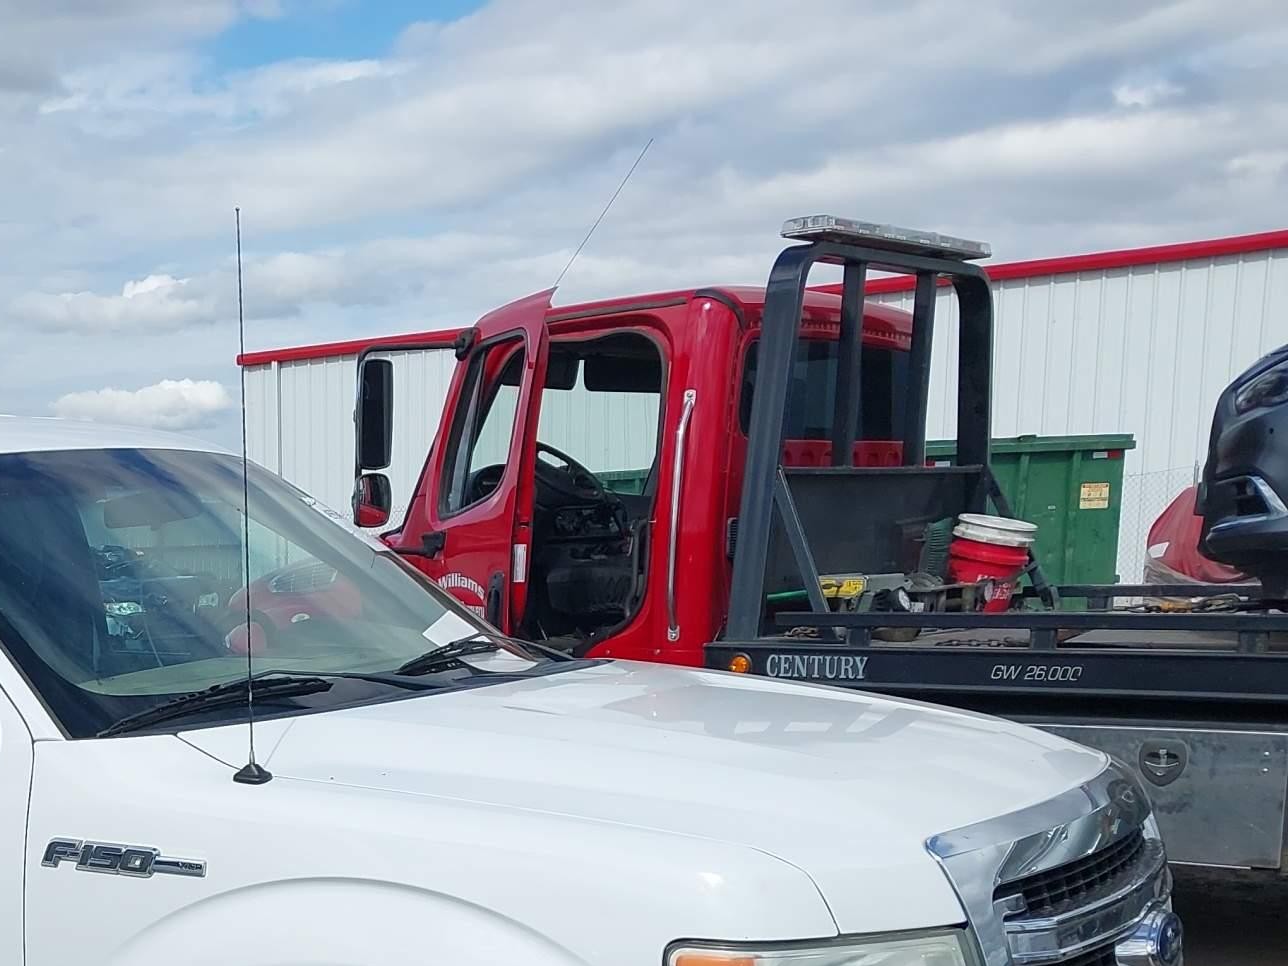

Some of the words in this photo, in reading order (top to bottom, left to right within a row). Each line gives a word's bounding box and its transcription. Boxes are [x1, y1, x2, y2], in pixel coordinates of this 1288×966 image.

[438, 572, 485, 601] Williams
[766, 653, 869, 680] CENTURY
[990, 664, 1022, 680] GW
[41, 837, 160, 878] F-150
